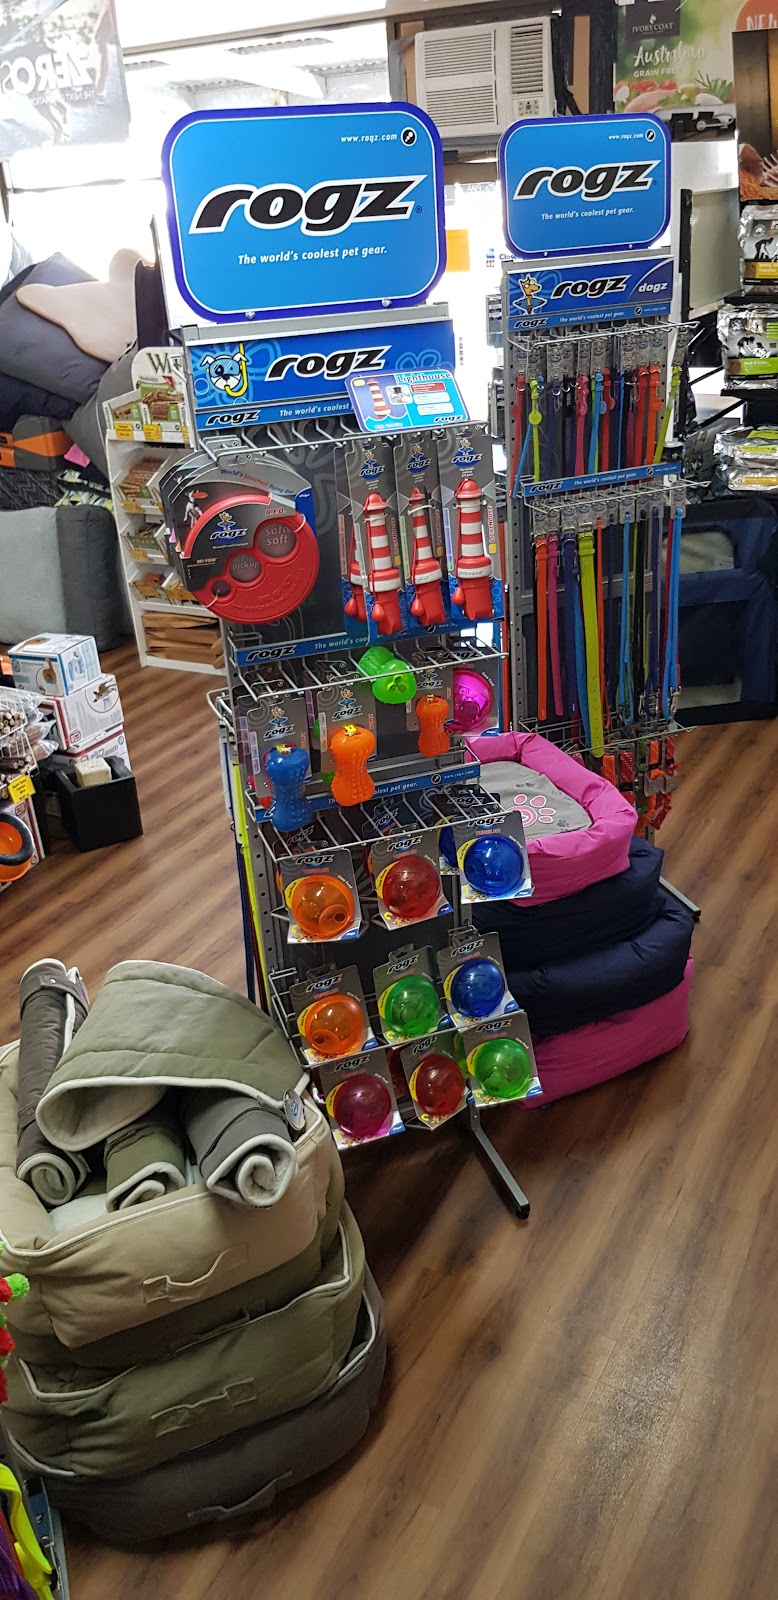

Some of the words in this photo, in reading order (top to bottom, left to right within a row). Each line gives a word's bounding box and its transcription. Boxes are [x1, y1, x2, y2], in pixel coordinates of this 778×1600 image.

[633, 69, 659, 78] GRAIN
[340, 133, 398, 143] www.rogz.com
[608, 133, 644, 141] www.rogz.com
[513, 160, 661, 201] rogz
[188, 175, 428, 236] rogz
[541, 212, 553, 220] The
[555, 210, 579, 219] world's
[581, 208, 604, 217] coolest
[605, 208, 616, 217] pet
[618, 206, 634, 215] gear.
[238, 254, 257, 265] The
[260, 250, 299, 263] world's
[302, 248, 340, 260] coolest
[342, 247, 359, 259] pet
[362, 245, 388, 256] gear.
[550, 274, 632, 300] rogz
[638, 282, 668, 294] dogz
[514, 317, 549, 328] rogz
[265, 345, 392, 382] rogz
[397, 373, 451, 384] Lighthouse
[205, 410, 262, 426] rogz
[280, 407, 293, 417] The
[294, 405, 321, 416] world's
[323, 402, 350, 412] coolest
[406, 458, 432, 470] rogz
[451, 453, 483, 464] rogz
[359, 465, 386, 477] rogz
[530, 481, 564, 493] rogz
[210, 528, 248, 540] rogz
[267, 534, 288, 546] soft
[246, 645, 298, 661] rogz
[329, 638, 354, 648] world's
[332, 706, 362, 719] rogz
[264, 723, 295, 738] rogz
[390, 784, 401, 793] pet
[402, 781, 418, 790] gear.
[387, 835, 423, 852] rogz
[295, 854, 334, 865] rogz
[451, 938, 484, 957] rogz
[387, 954, 419, 974] rogz
[306, 974, 343, 993] rogz
[476, 1019, 512, 1032] rogz
[412, 1034, 437, 1055] rogz
[335, 1054, 370, 1072] rogz
